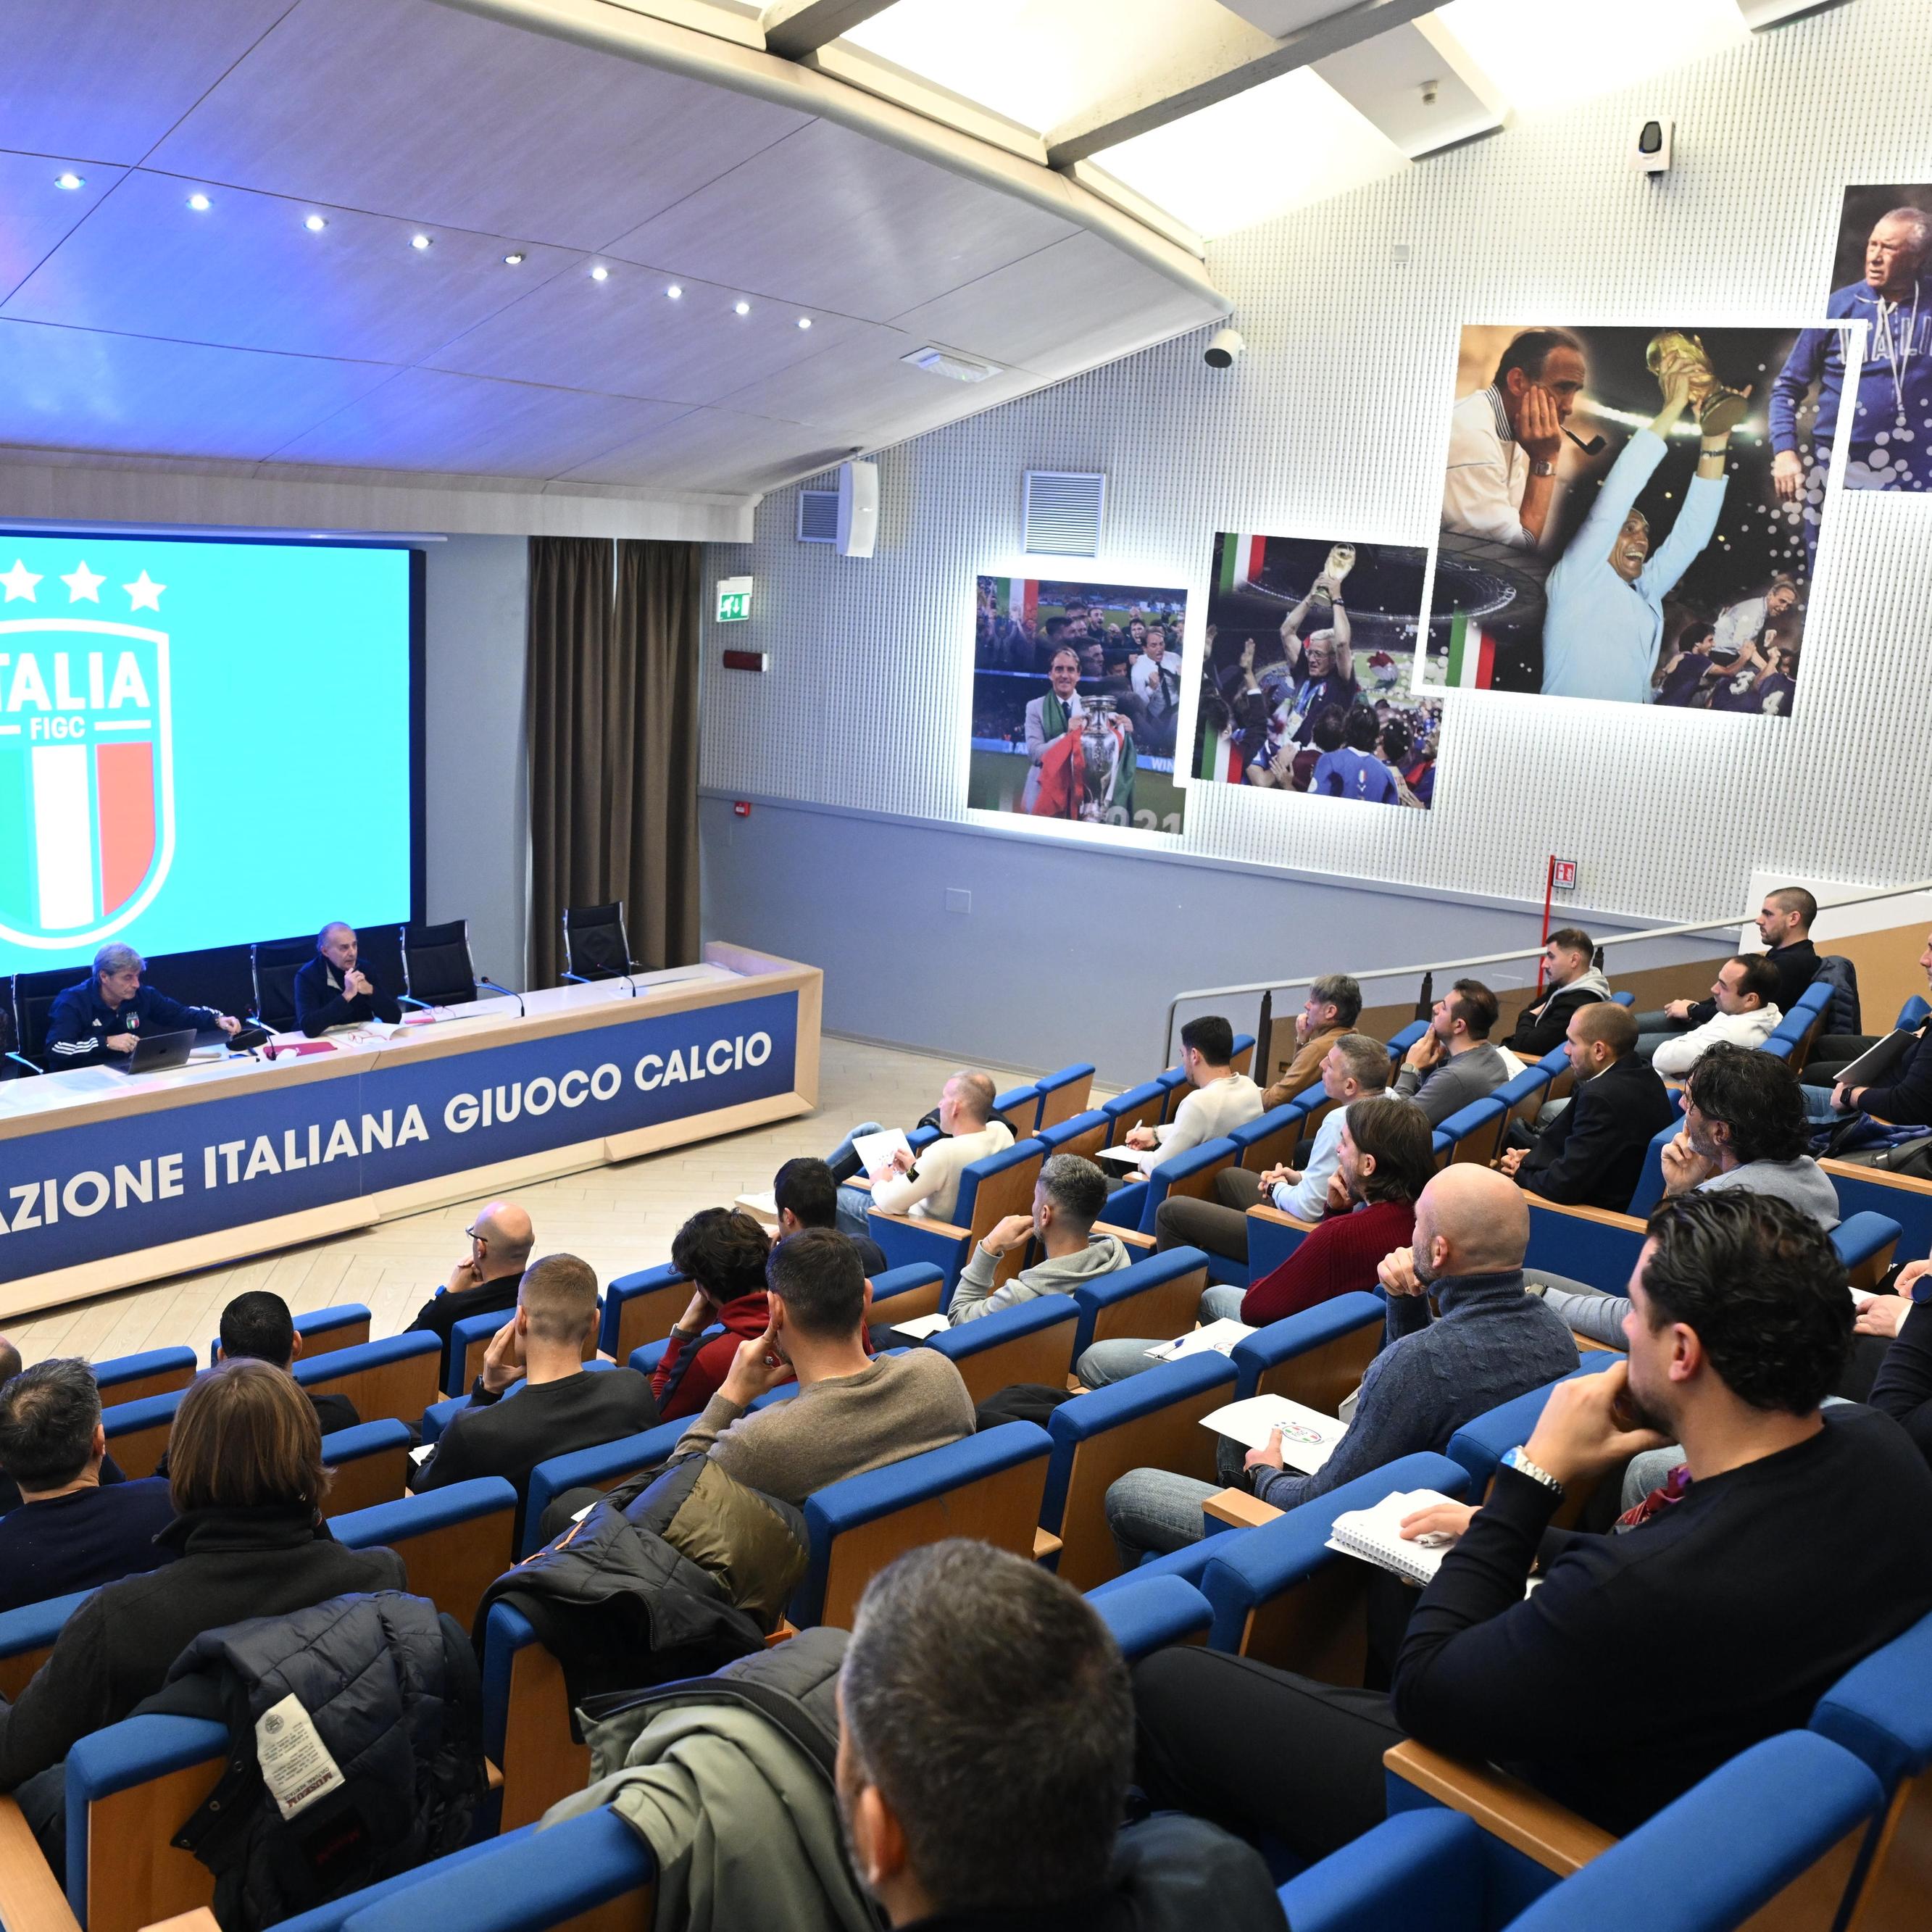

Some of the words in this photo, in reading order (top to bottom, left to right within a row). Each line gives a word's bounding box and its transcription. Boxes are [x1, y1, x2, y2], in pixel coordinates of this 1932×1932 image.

[1729, 670, 1755, 695] 3
[30, 716, 86, 740] FIGC
[0, 1152, 183, 1233] ZIONE
[204, 1103, 429, 1189] ITALIANA
[444, 1062, 622, 1133] GIUOCO
[634, 1031, 772, 1091] CALCIO
[286, 1771, 333, 1808] MUSEUM
